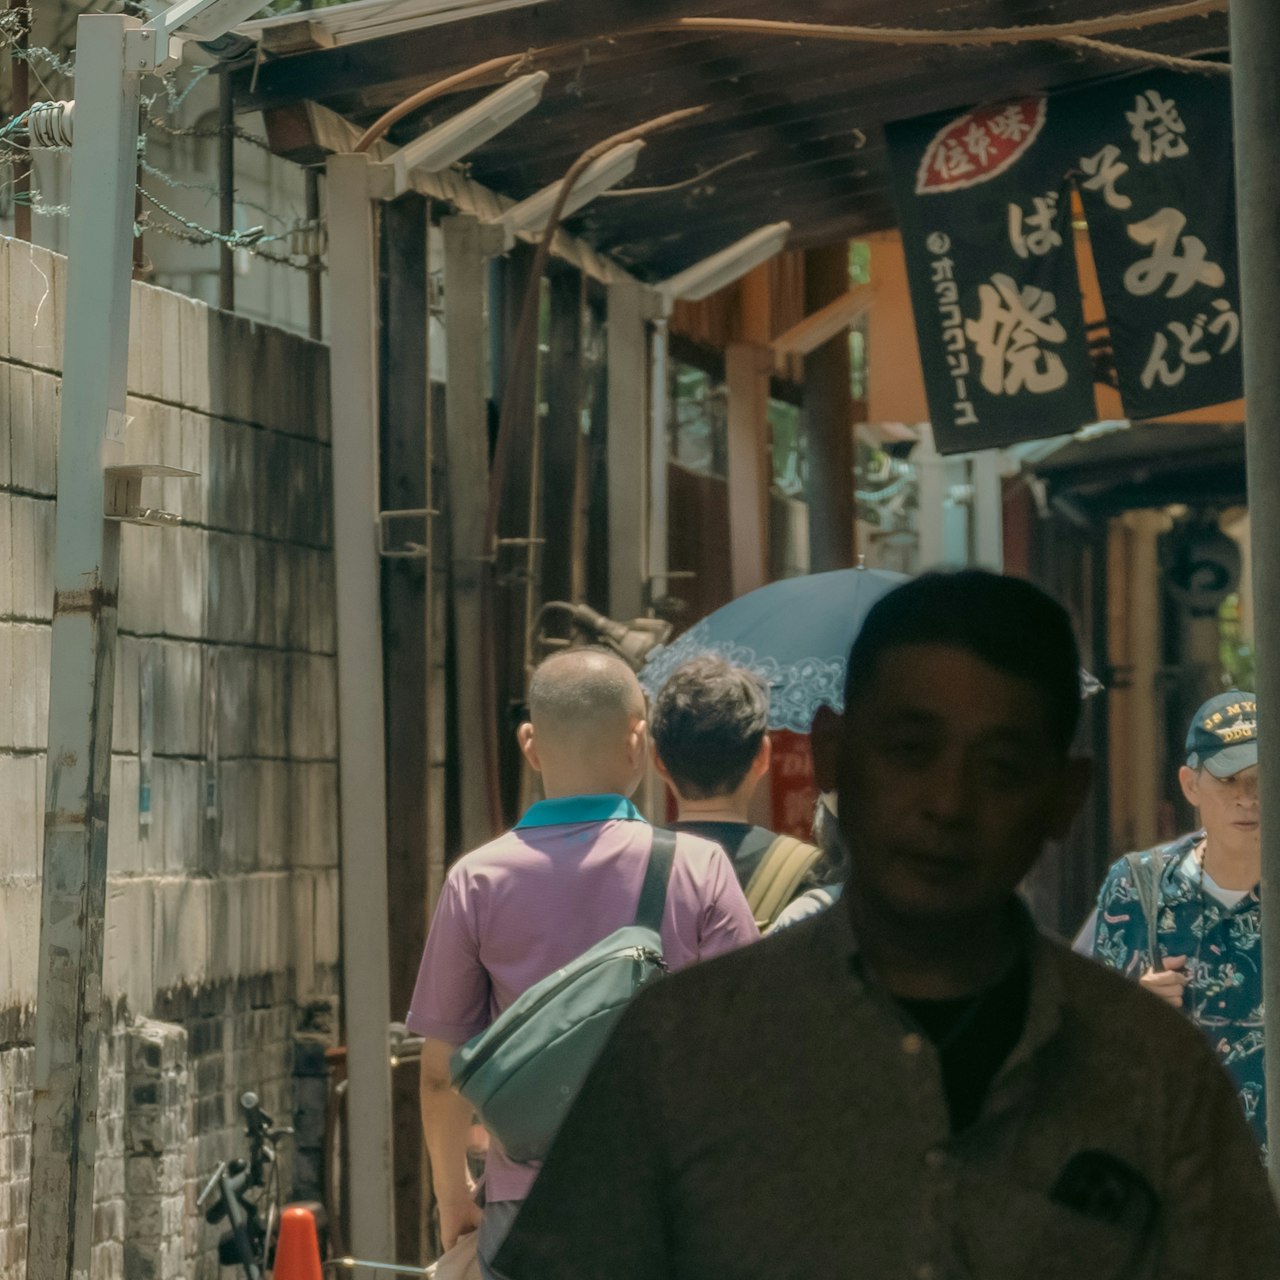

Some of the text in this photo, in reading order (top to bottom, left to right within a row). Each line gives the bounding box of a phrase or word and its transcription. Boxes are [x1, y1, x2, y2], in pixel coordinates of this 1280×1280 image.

[930, 257, 980, 427] オタフクソース
